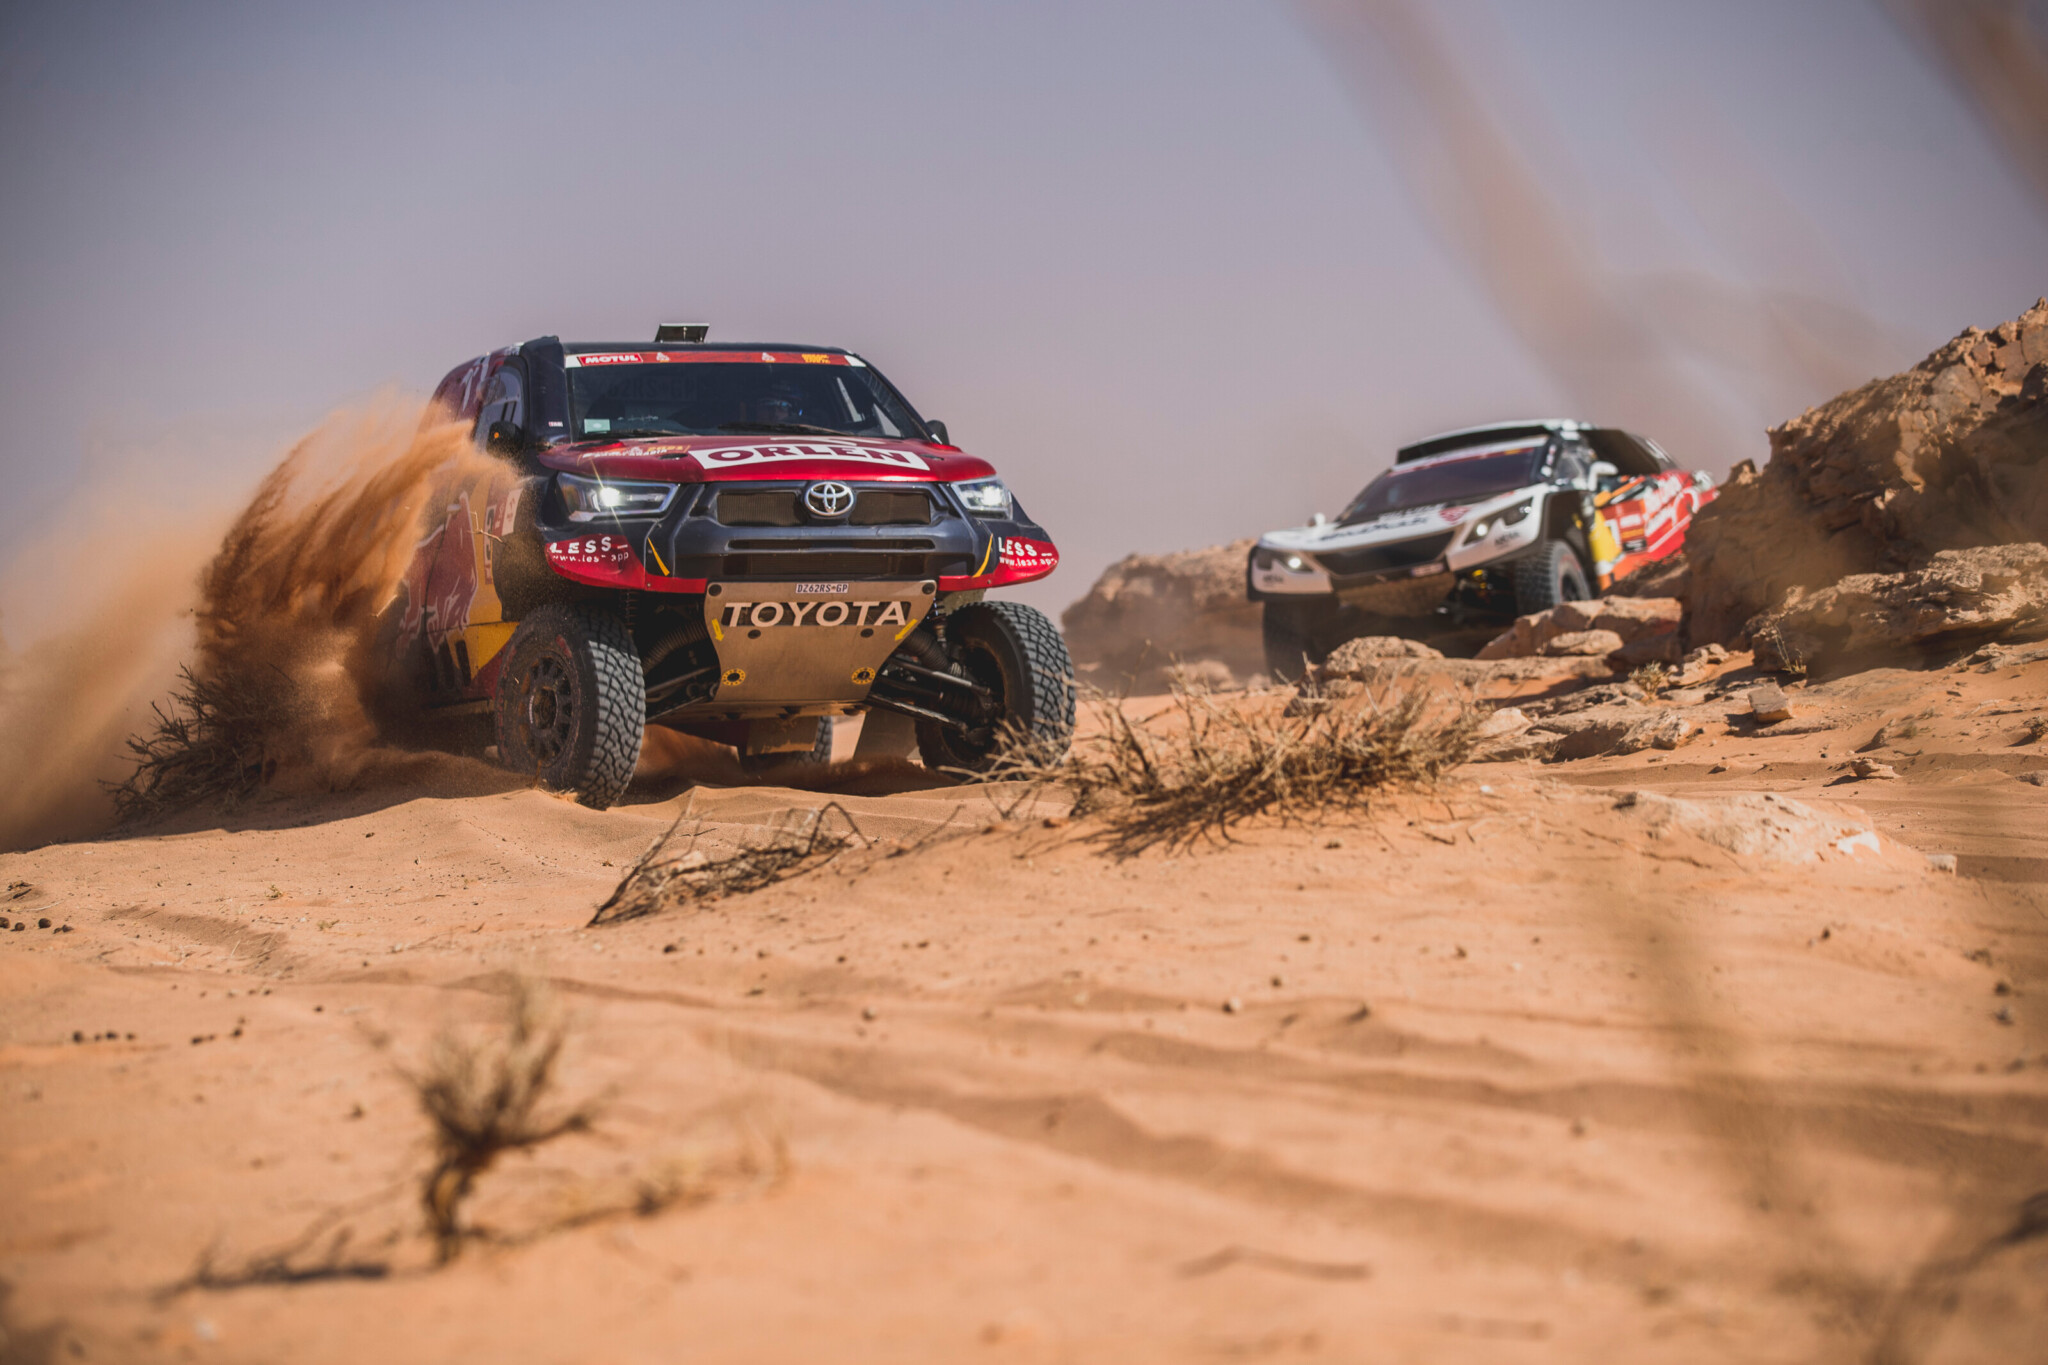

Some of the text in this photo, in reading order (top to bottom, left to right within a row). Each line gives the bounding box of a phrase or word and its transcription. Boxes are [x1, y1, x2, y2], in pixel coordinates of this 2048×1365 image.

[585, 355, 639, 364] MOTUL
[707, 444, 912, 464] ORLEN
[724, 601, 906, 627] TOYOTA
